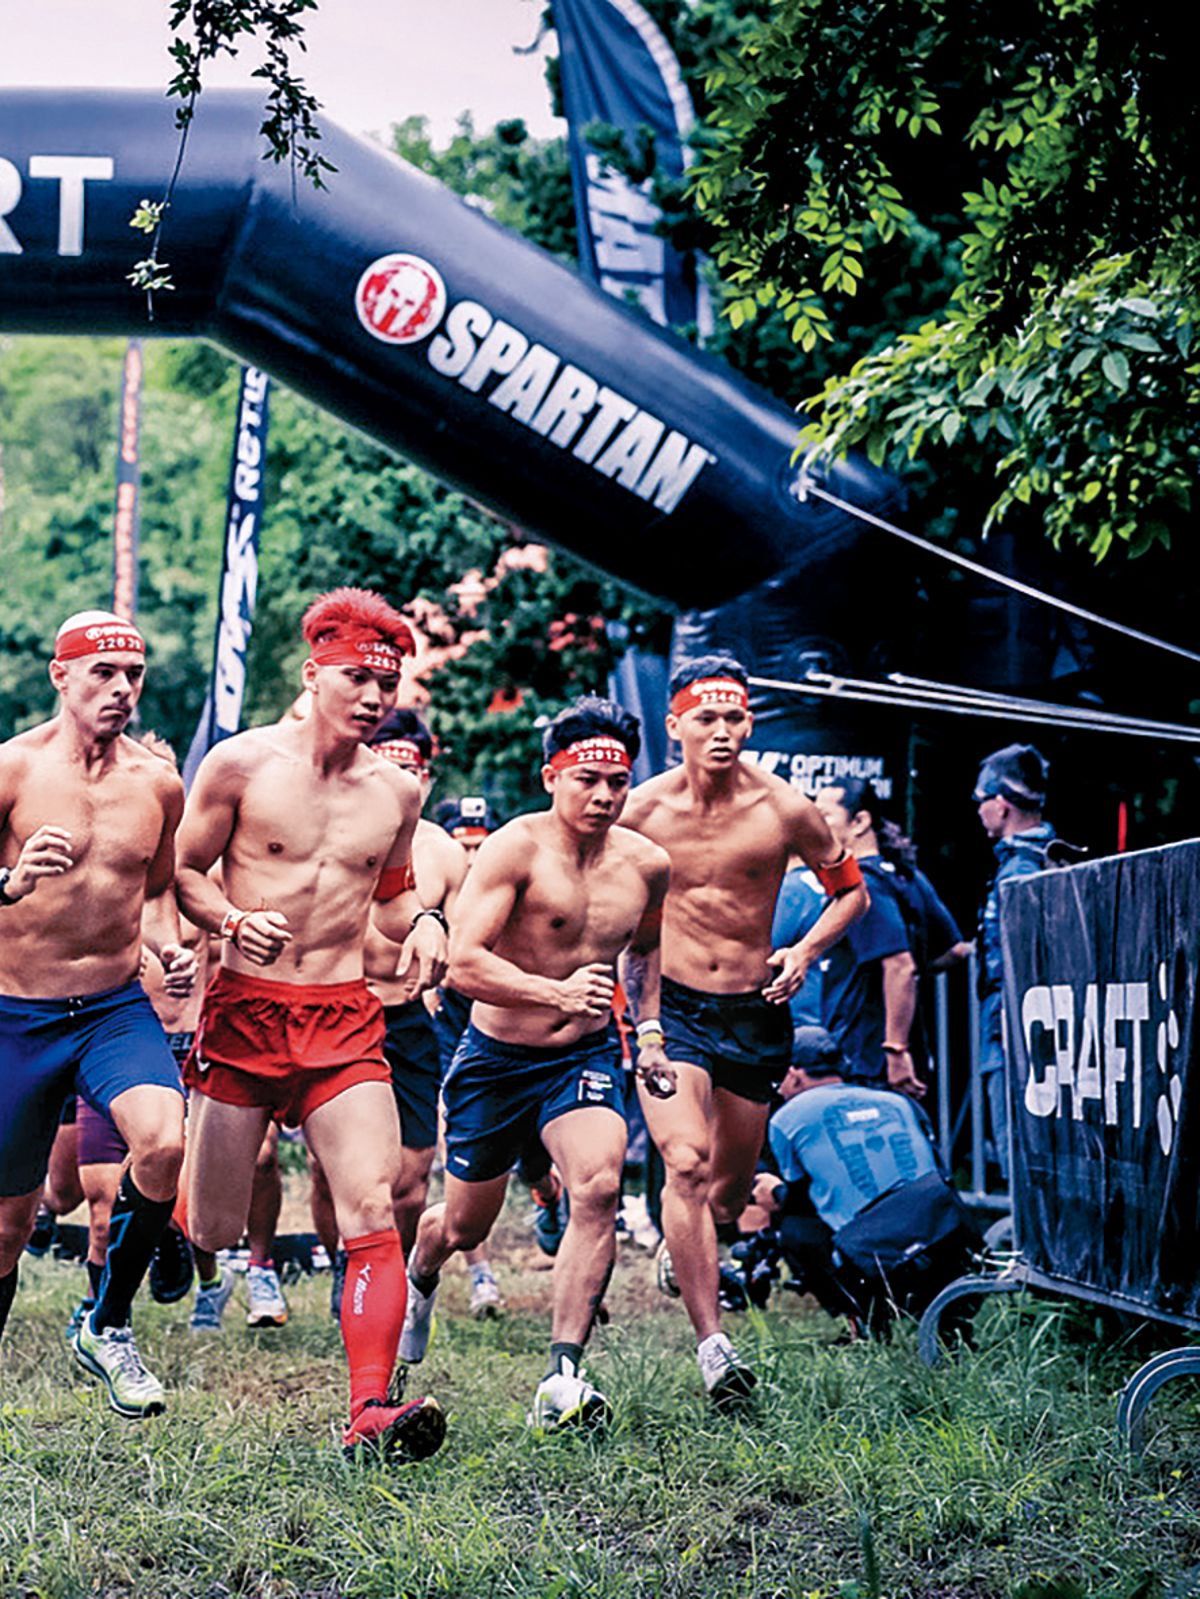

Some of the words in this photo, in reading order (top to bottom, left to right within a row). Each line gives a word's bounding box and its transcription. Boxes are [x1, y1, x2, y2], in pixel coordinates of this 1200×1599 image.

[427, 300, 712, 514] SPARTAN
[790, 754, 884, 779] OPTIMUM
[1022, 981, 1149, 1129] CRAFT
